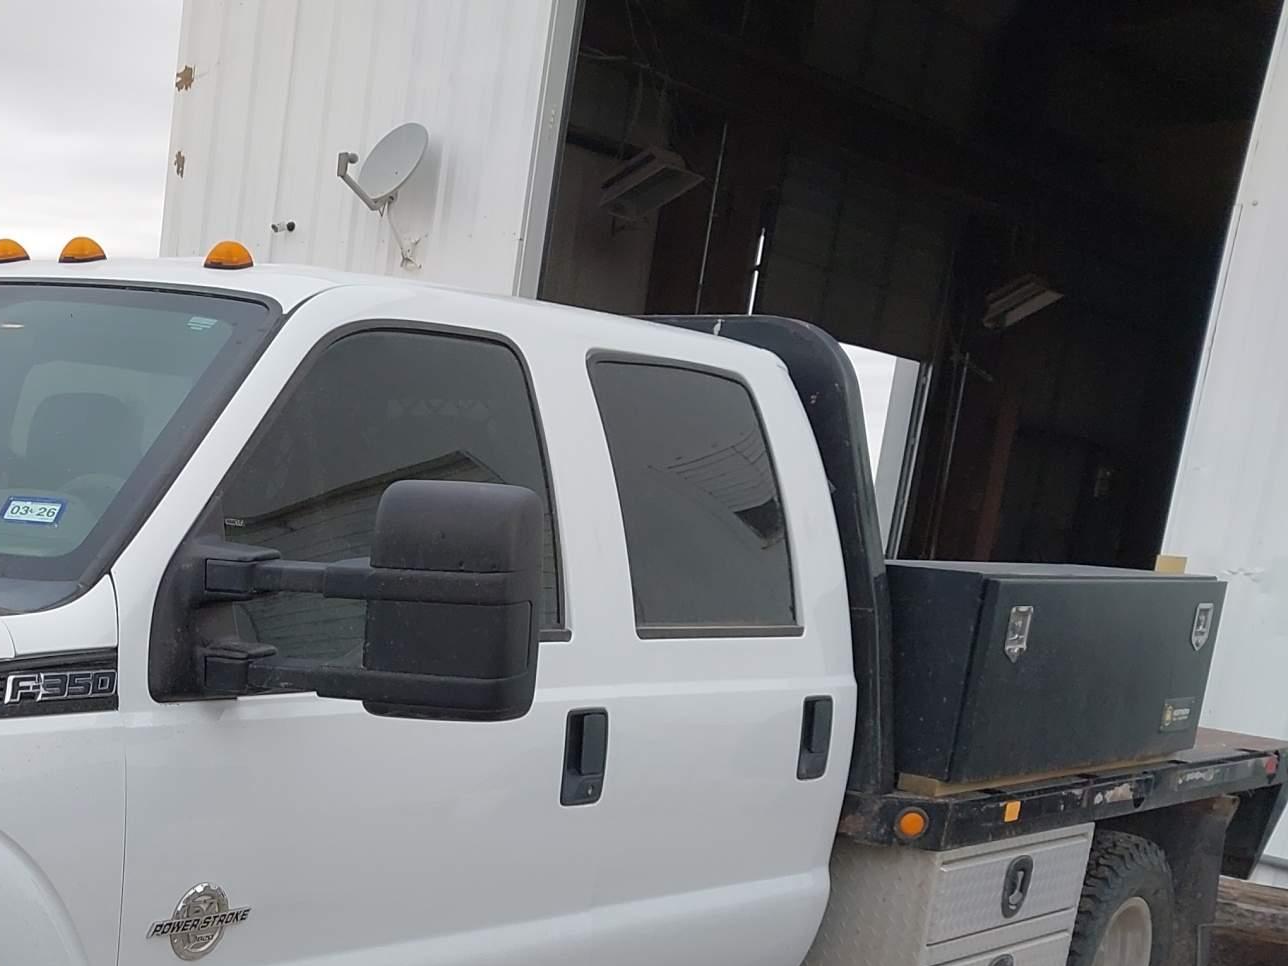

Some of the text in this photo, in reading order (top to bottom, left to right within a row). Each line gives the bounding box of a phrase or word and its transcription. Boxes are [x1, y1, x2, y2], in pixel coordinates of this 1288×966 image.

[10, 504, 57, 518] 03 26
[3, 669, 118, 705] F-350
[151, 908, 252, 938] POWER STROKE
